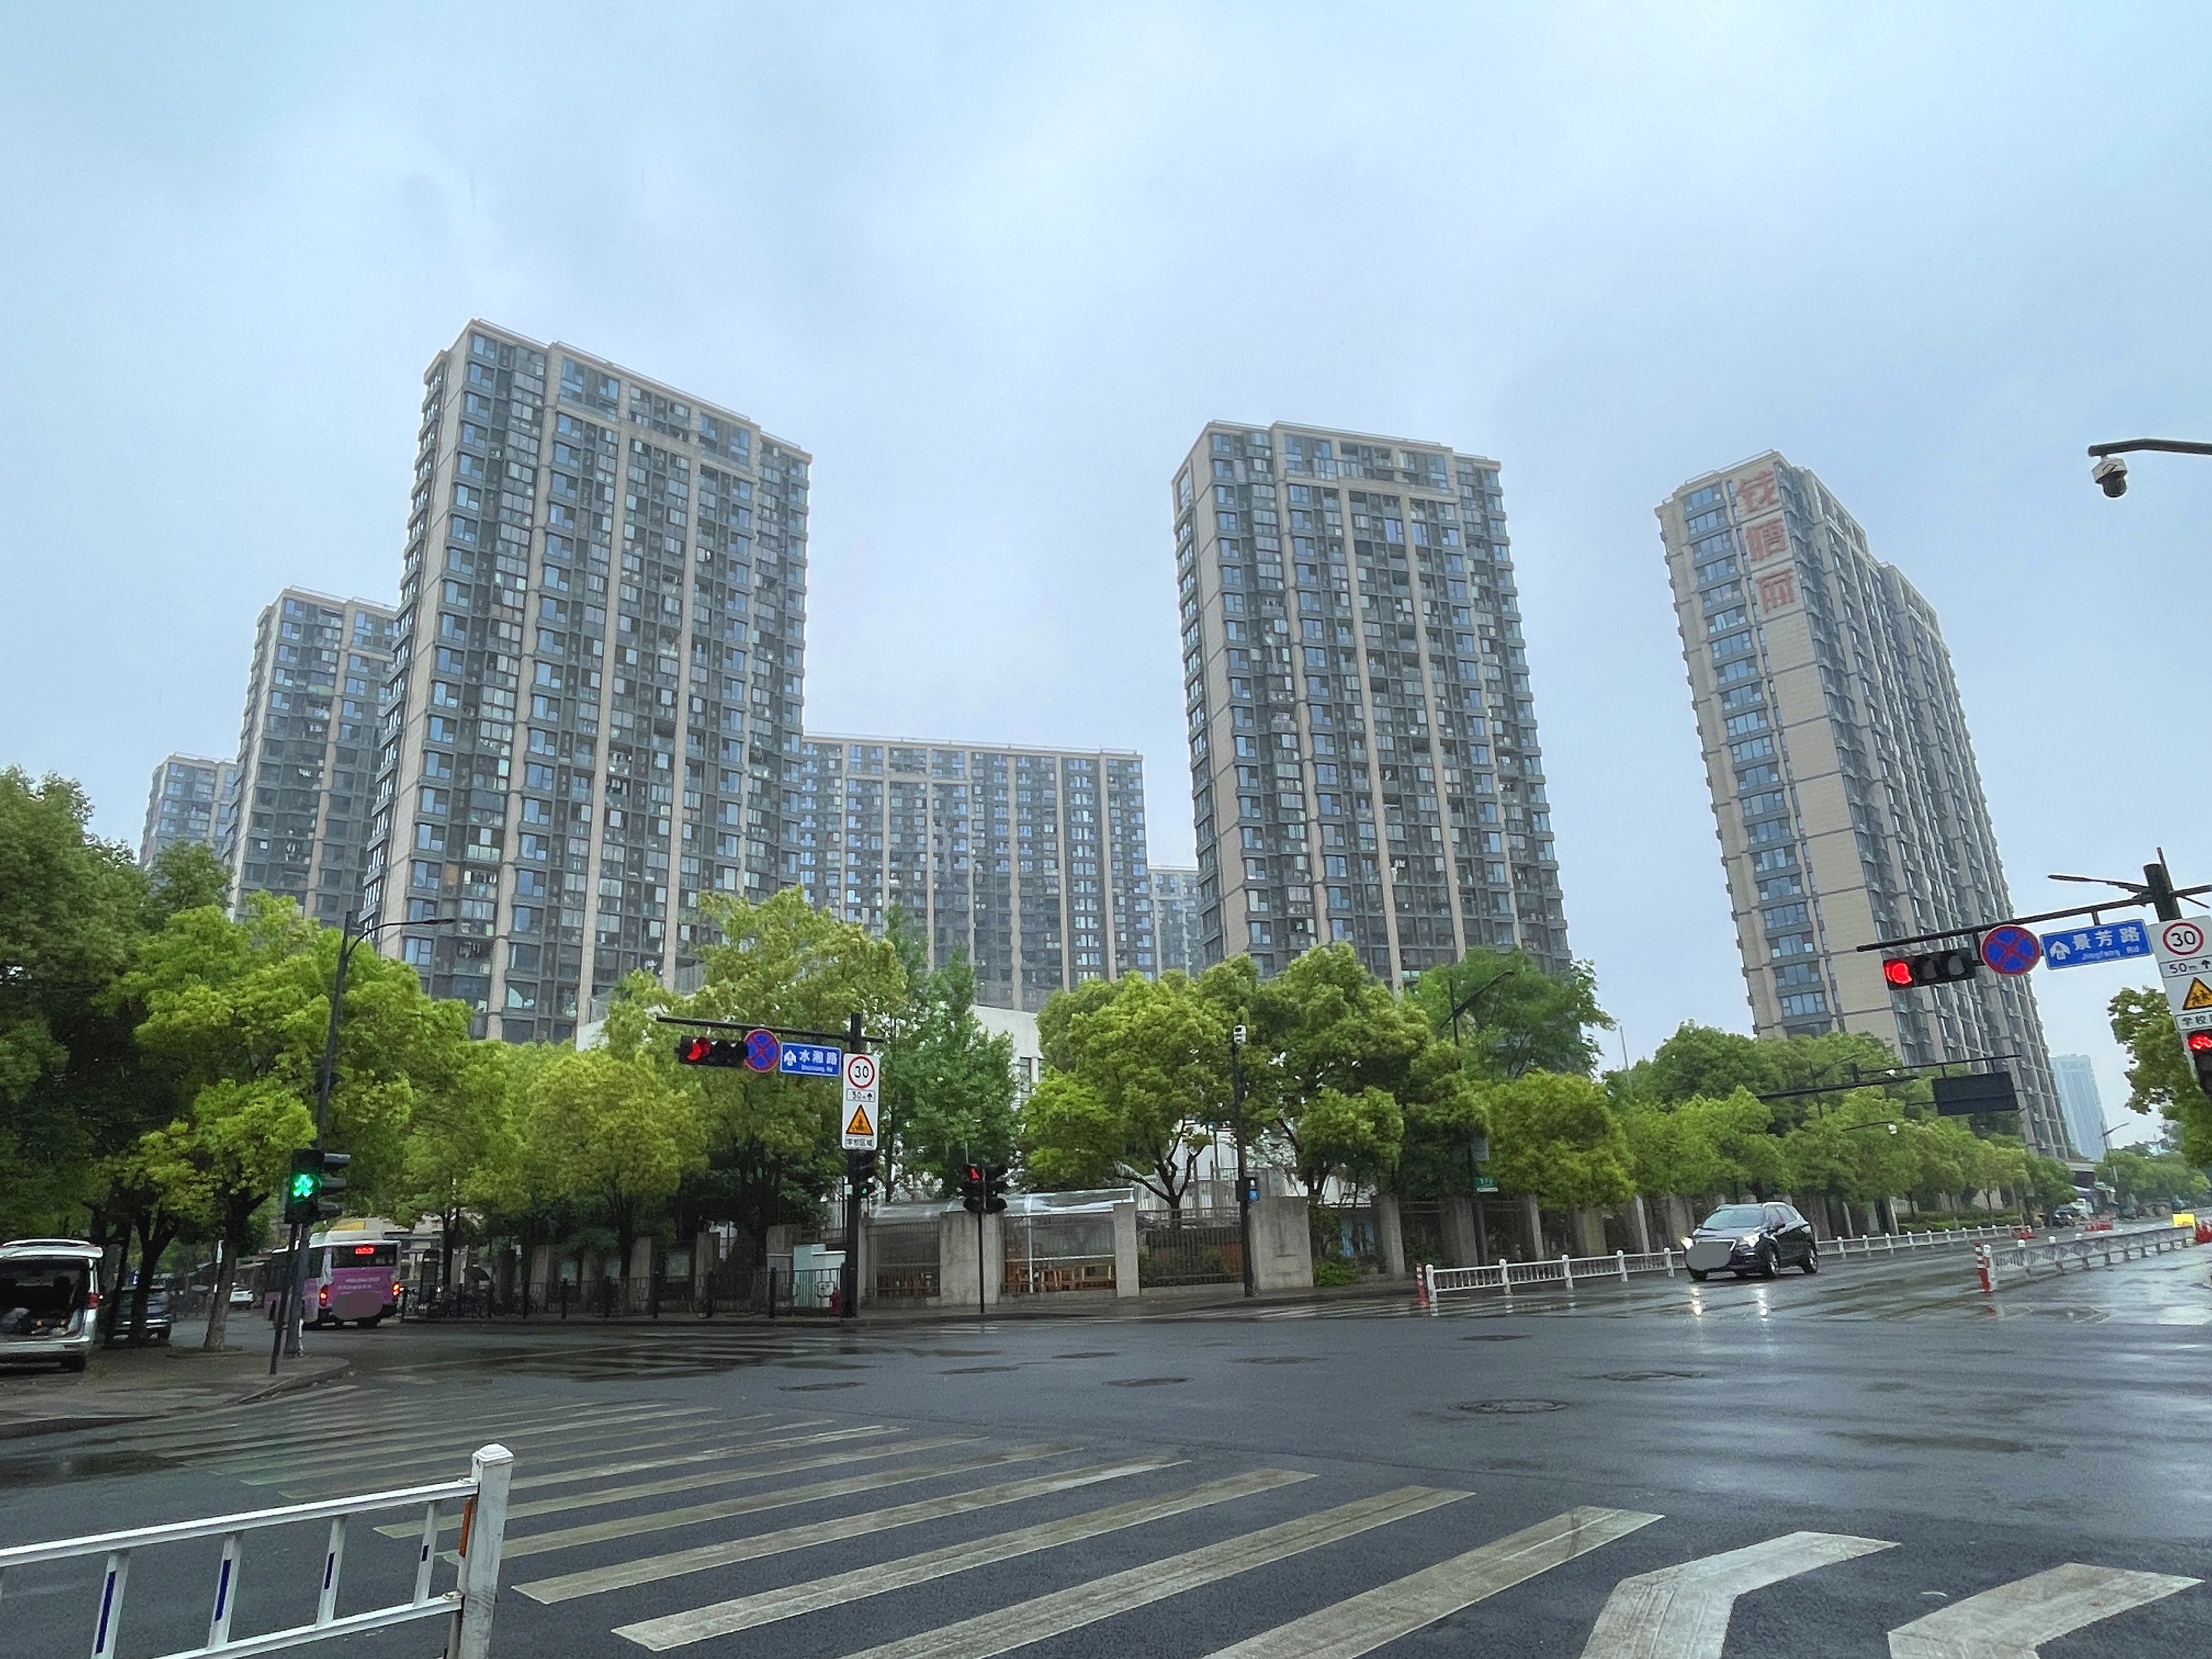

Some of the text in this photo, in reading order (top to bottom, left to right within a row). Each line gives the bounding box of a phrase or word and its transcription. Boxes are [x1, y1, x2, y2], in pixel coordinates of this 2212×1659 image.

[2072, 926, 2140, 951] 景芳路
[2170, 930, 2197, 947] 30
[2169, 962, 2197, 974] 50m
[2182, 1013, 2212, 1026] 学校
[854, 1065, 869, 1079] 30
